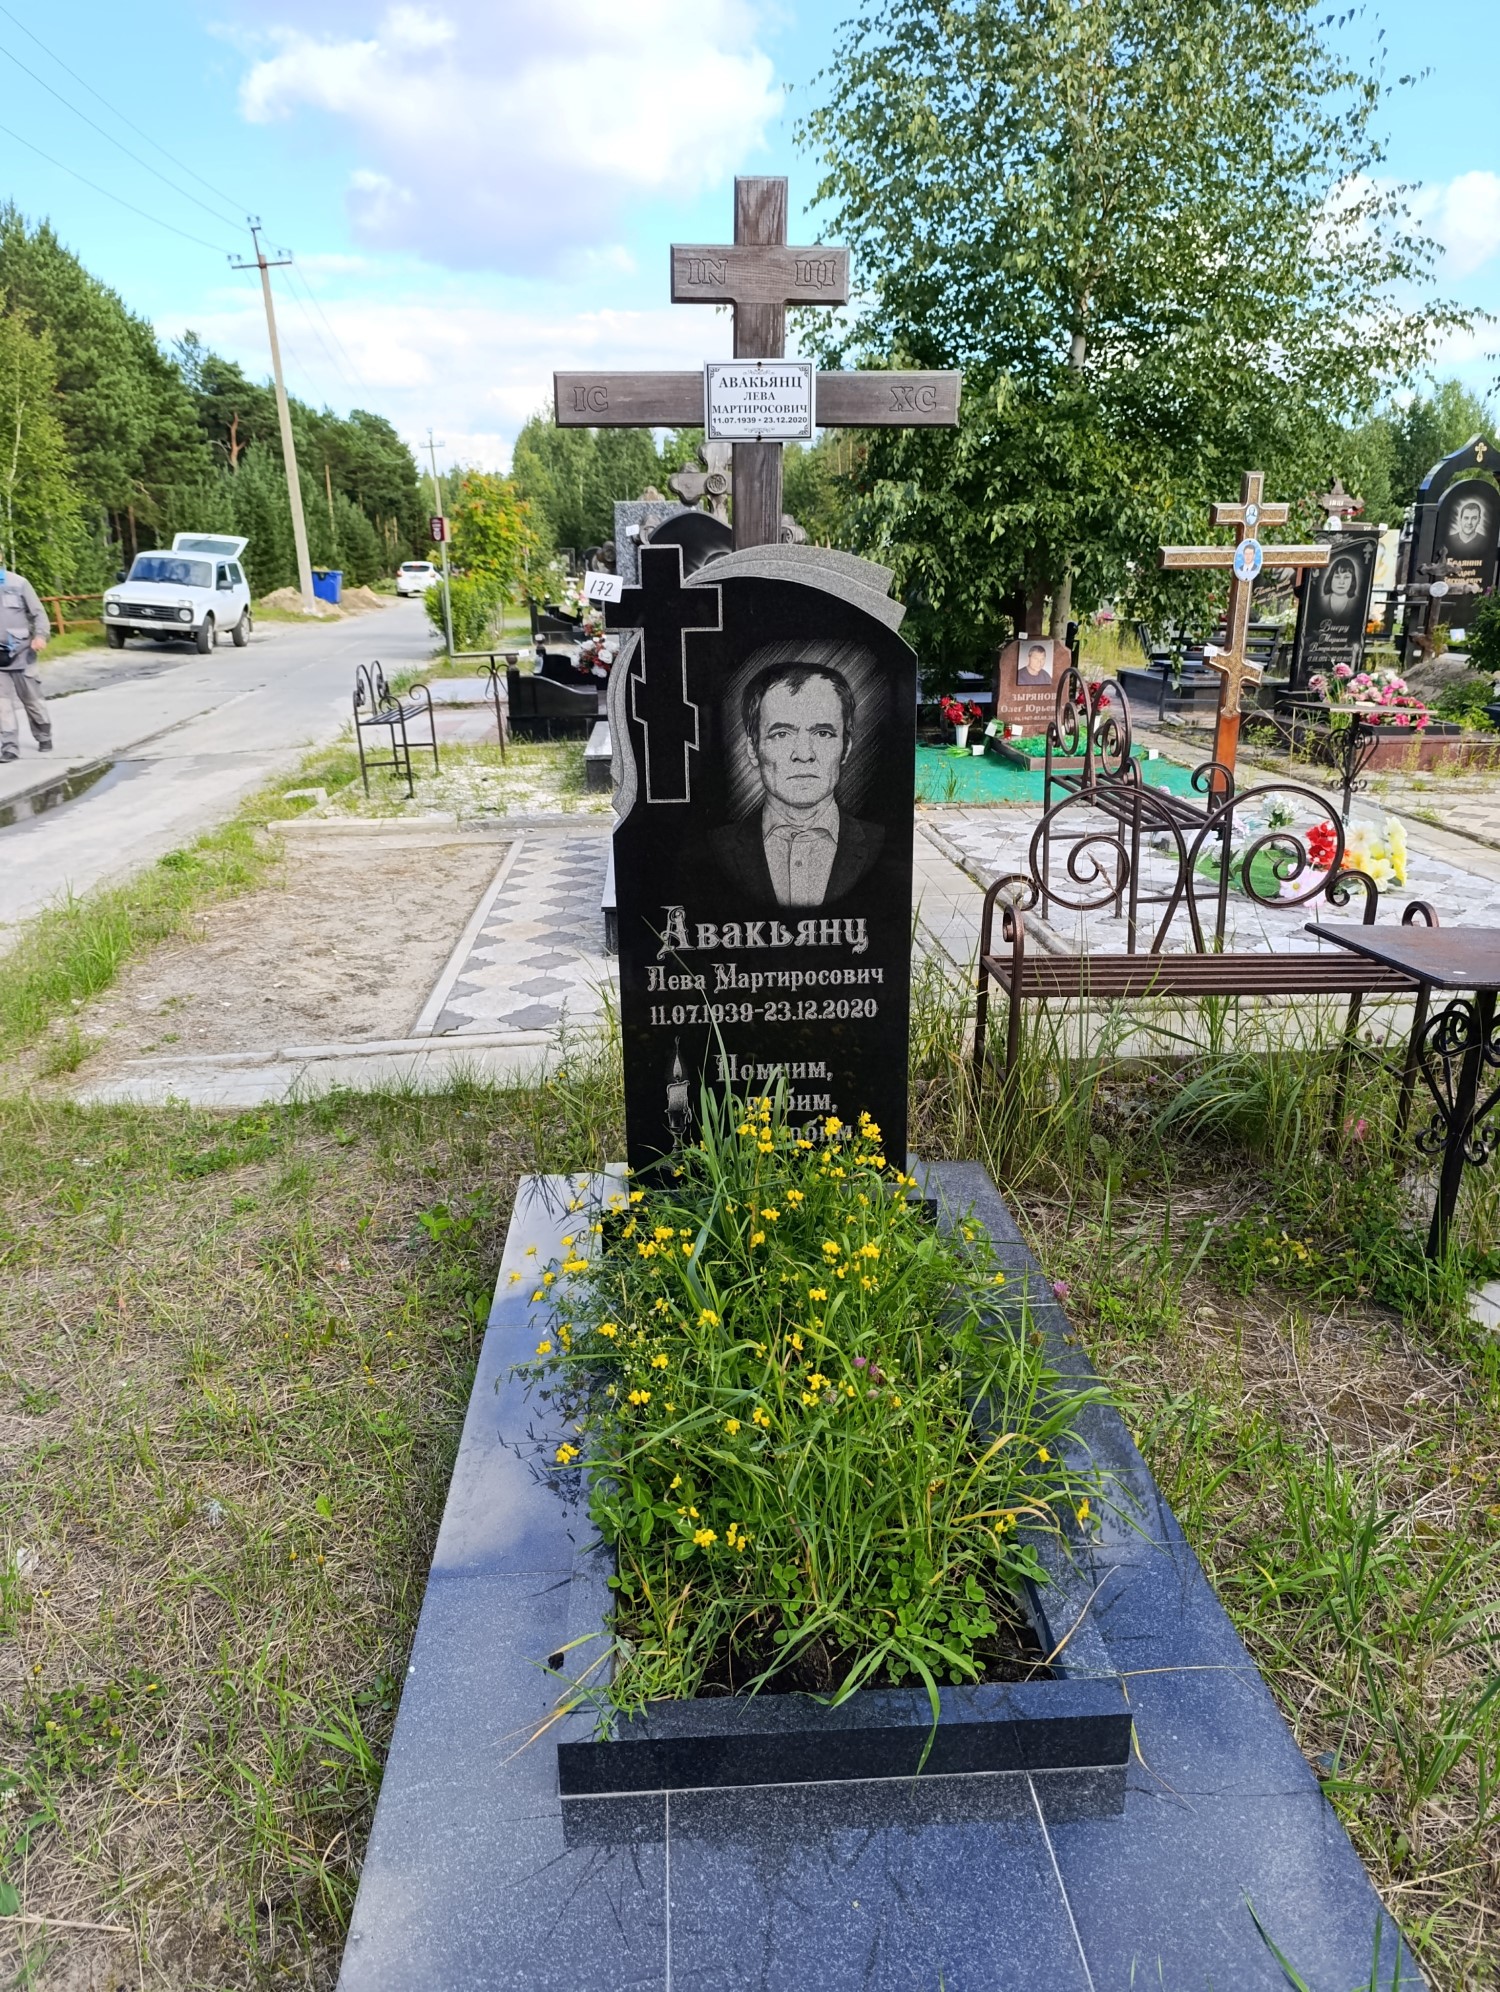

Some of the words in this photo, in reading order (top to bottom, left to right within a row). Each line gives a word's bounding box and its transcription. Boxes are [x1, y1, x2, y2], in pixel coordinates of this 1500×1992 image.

[719, 376, 802, 389] АВАКЬЯНЦ
[743, 391, 775, 401] ЛЕВА
[711, 405, 807, 414] МАРТИРОСОВИЧ
[763, 416, 808, 424] 23.12.2020
[589, 579, 614, 597] 172
[1001, 705, 1023, 713] Олег
[656, 905, 869, 961] Авакьянц
[645, 965, 706, 992] Лева
[710, 962, 885, 994] Мартиросович
